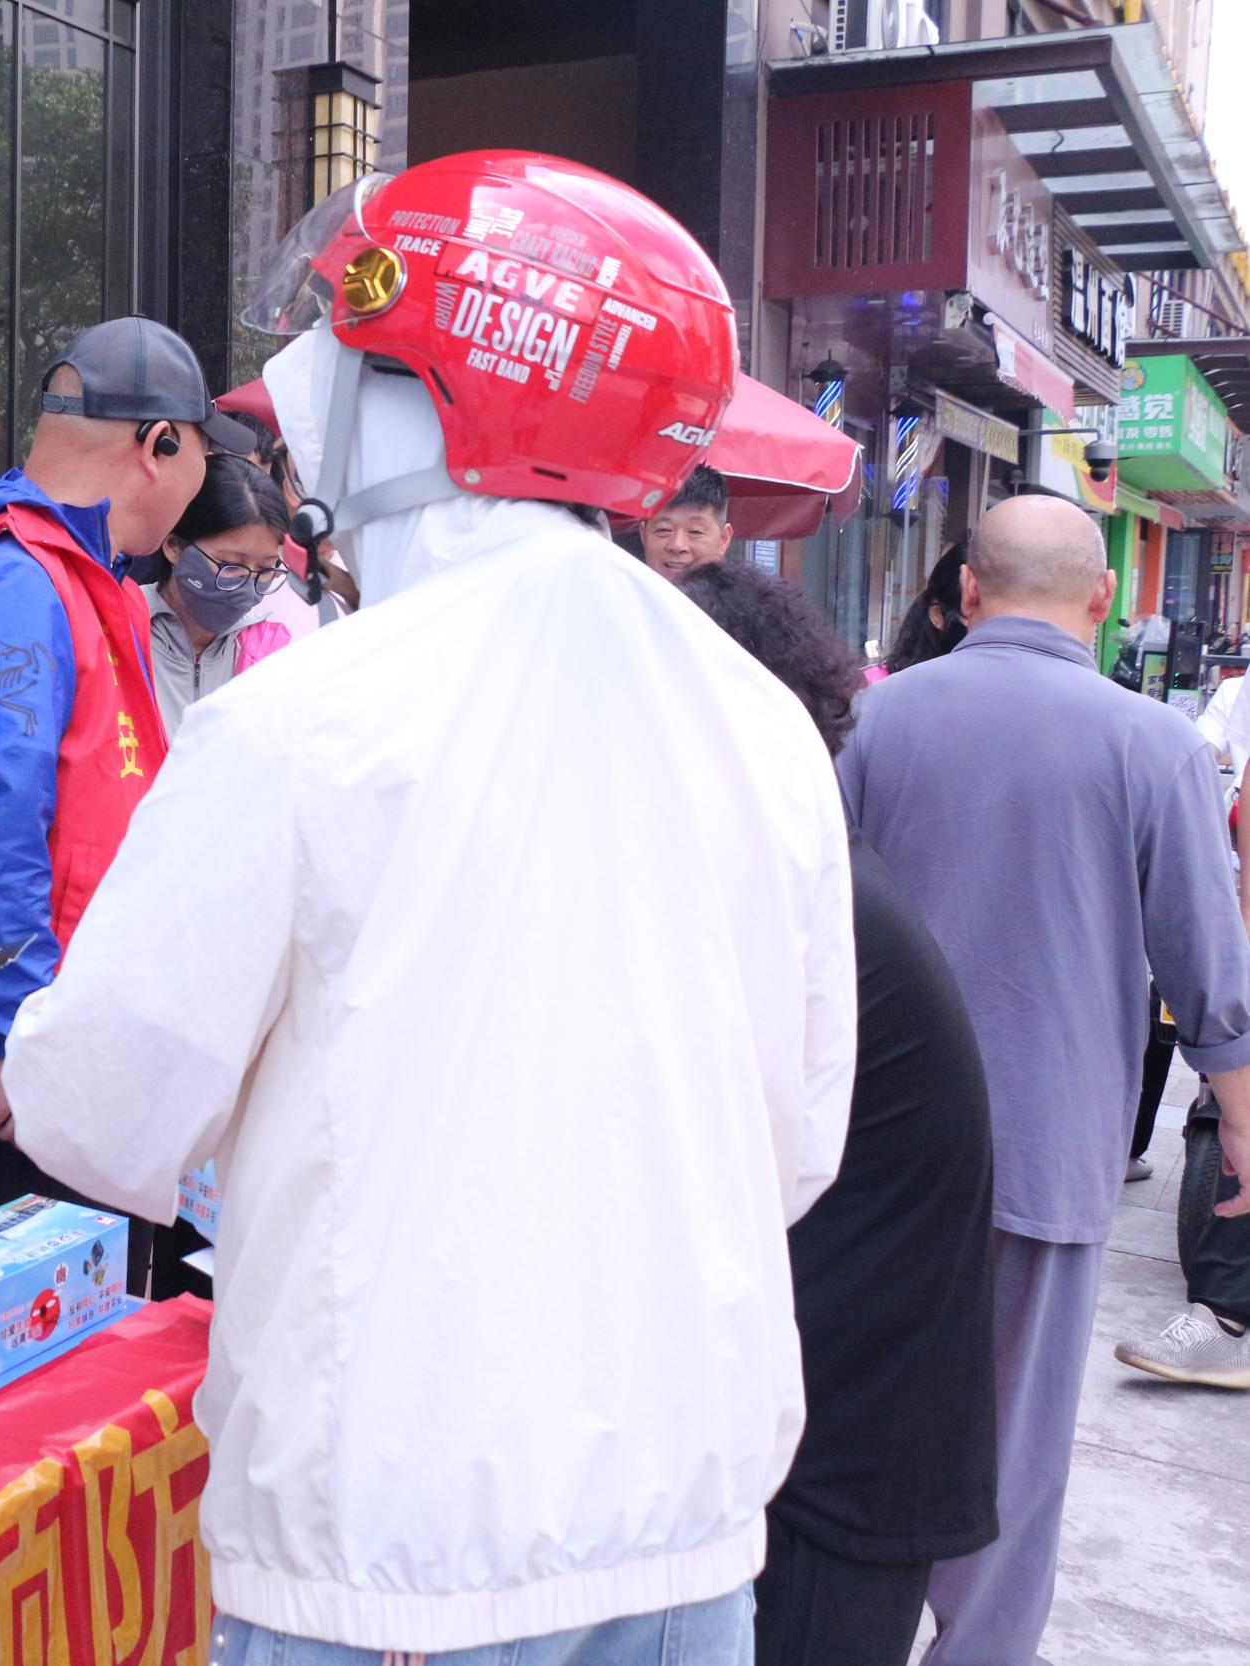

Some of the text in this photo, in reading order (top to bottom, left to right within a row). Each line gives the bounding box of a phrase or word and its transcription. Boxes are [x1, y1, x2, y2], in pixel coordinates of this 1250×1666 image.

[389, 209, 461, 236] PROTECTION
[393, 233, 442, 257] TRACE
[456, 249, 585, 313] AGVE
[451, 286, 581, 373] DESIGN
[601, 297, 658, 332] ADVANCED
[466, 347, 499, 373] FAST
[568, 349, 607, 404] FREEDOM
[590, 315, 619, 353] STYLE
